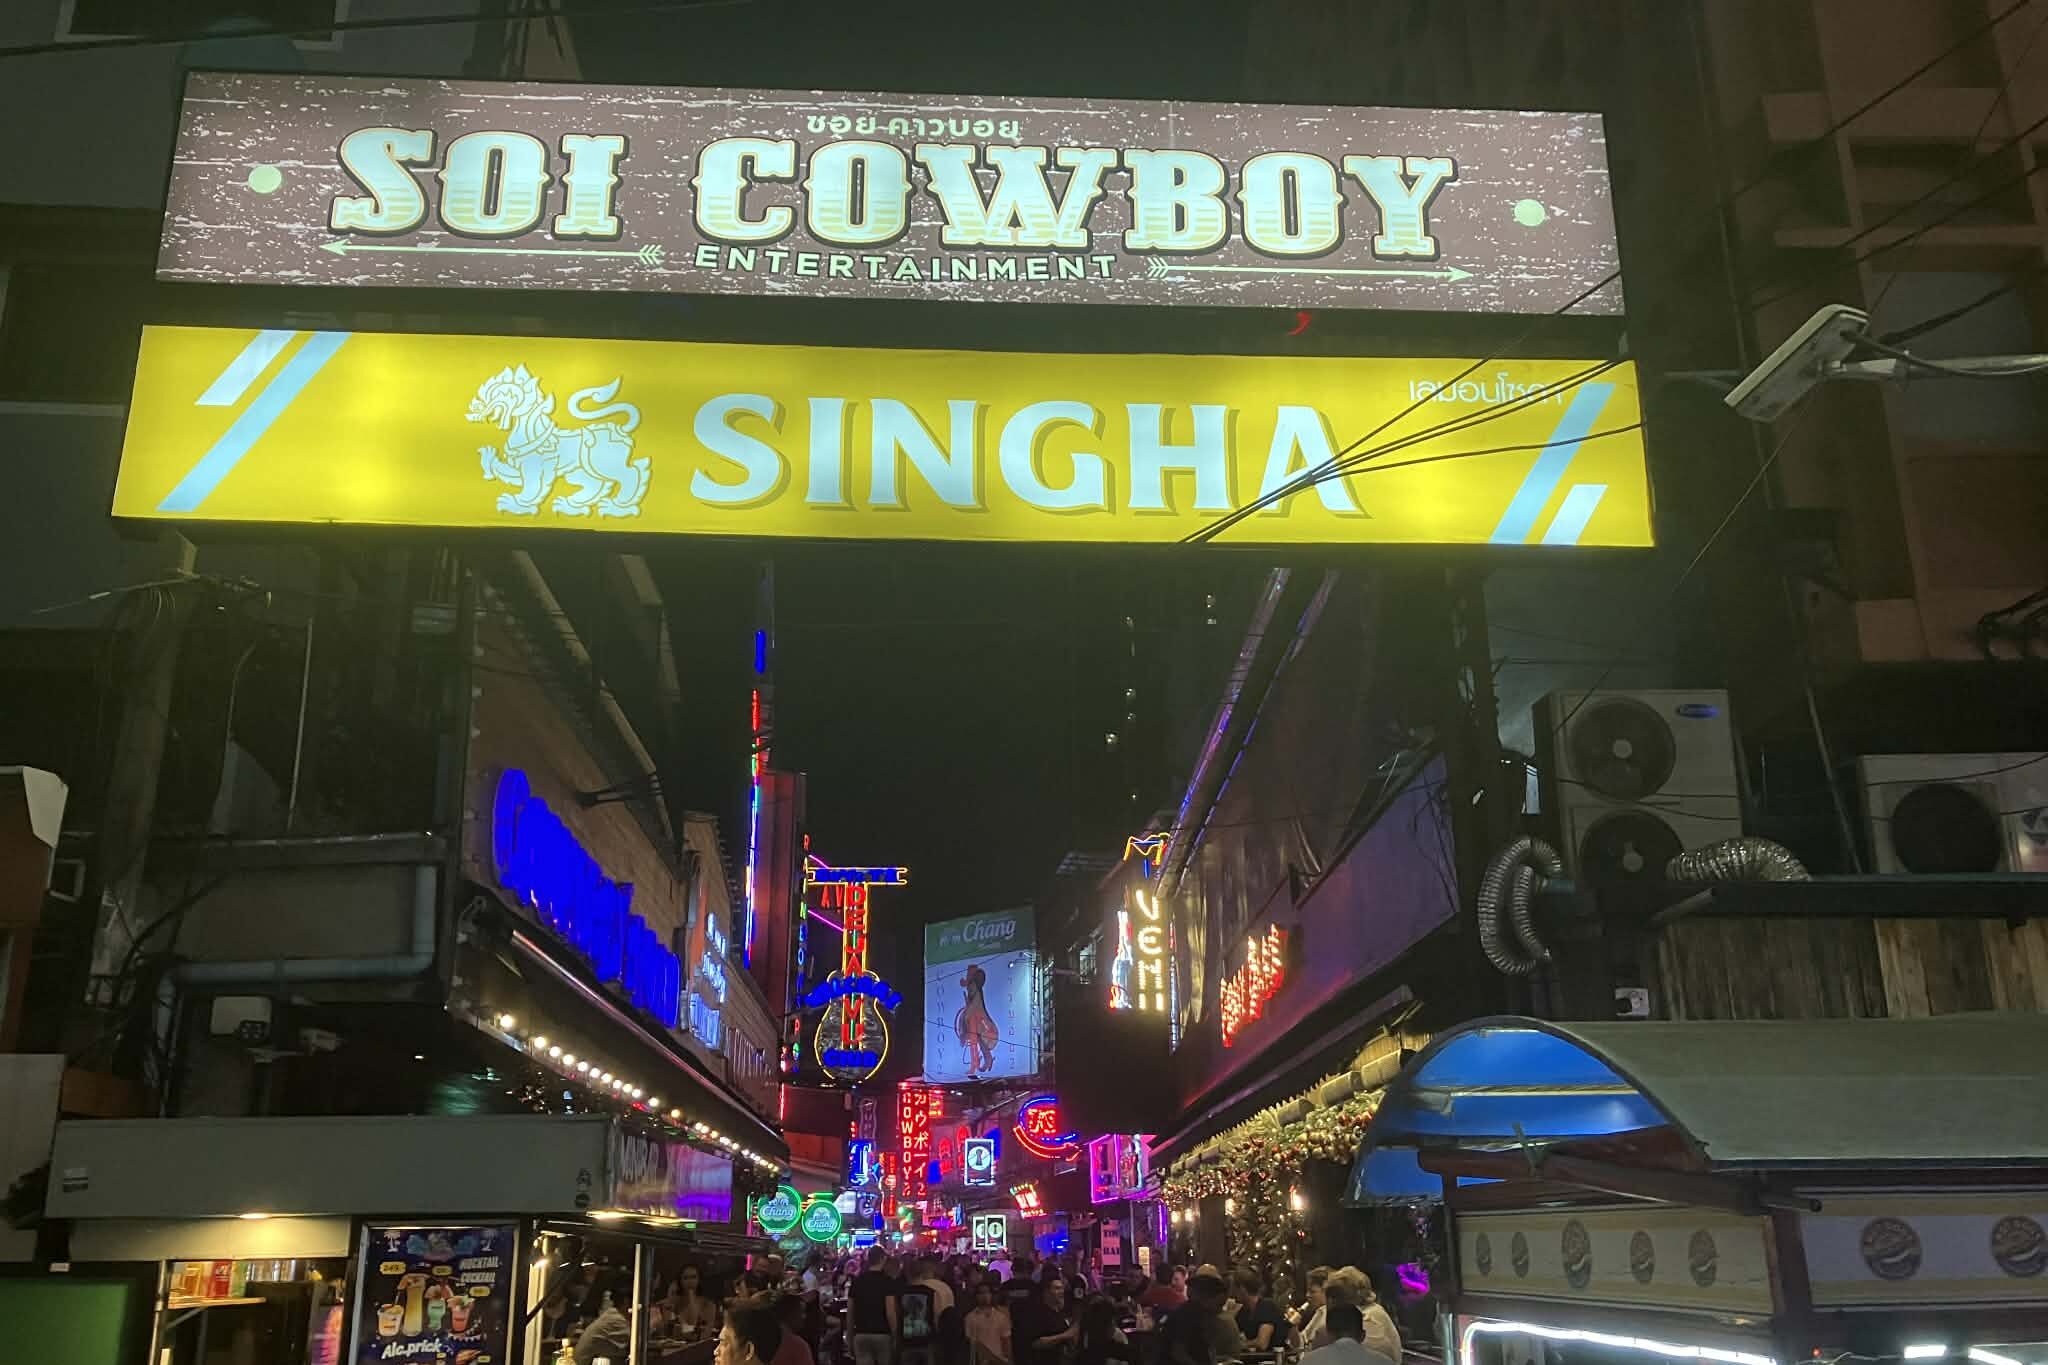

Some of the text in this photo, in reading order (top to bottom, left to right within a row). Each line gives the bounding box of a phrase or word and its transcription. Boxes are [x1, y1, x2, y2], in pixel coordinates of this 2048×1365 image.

[888, 117, 1019, 138] คาวบอย
[328, 127, 1458, 261] SOI COWBOY
[694, 243, 1116, 282] ENTERTAINMENT
[689, 393, 1370, 516] SINGHA
[963, 920, 1017, 943] Chang
[763, 1204, 794, 1217] Chang
